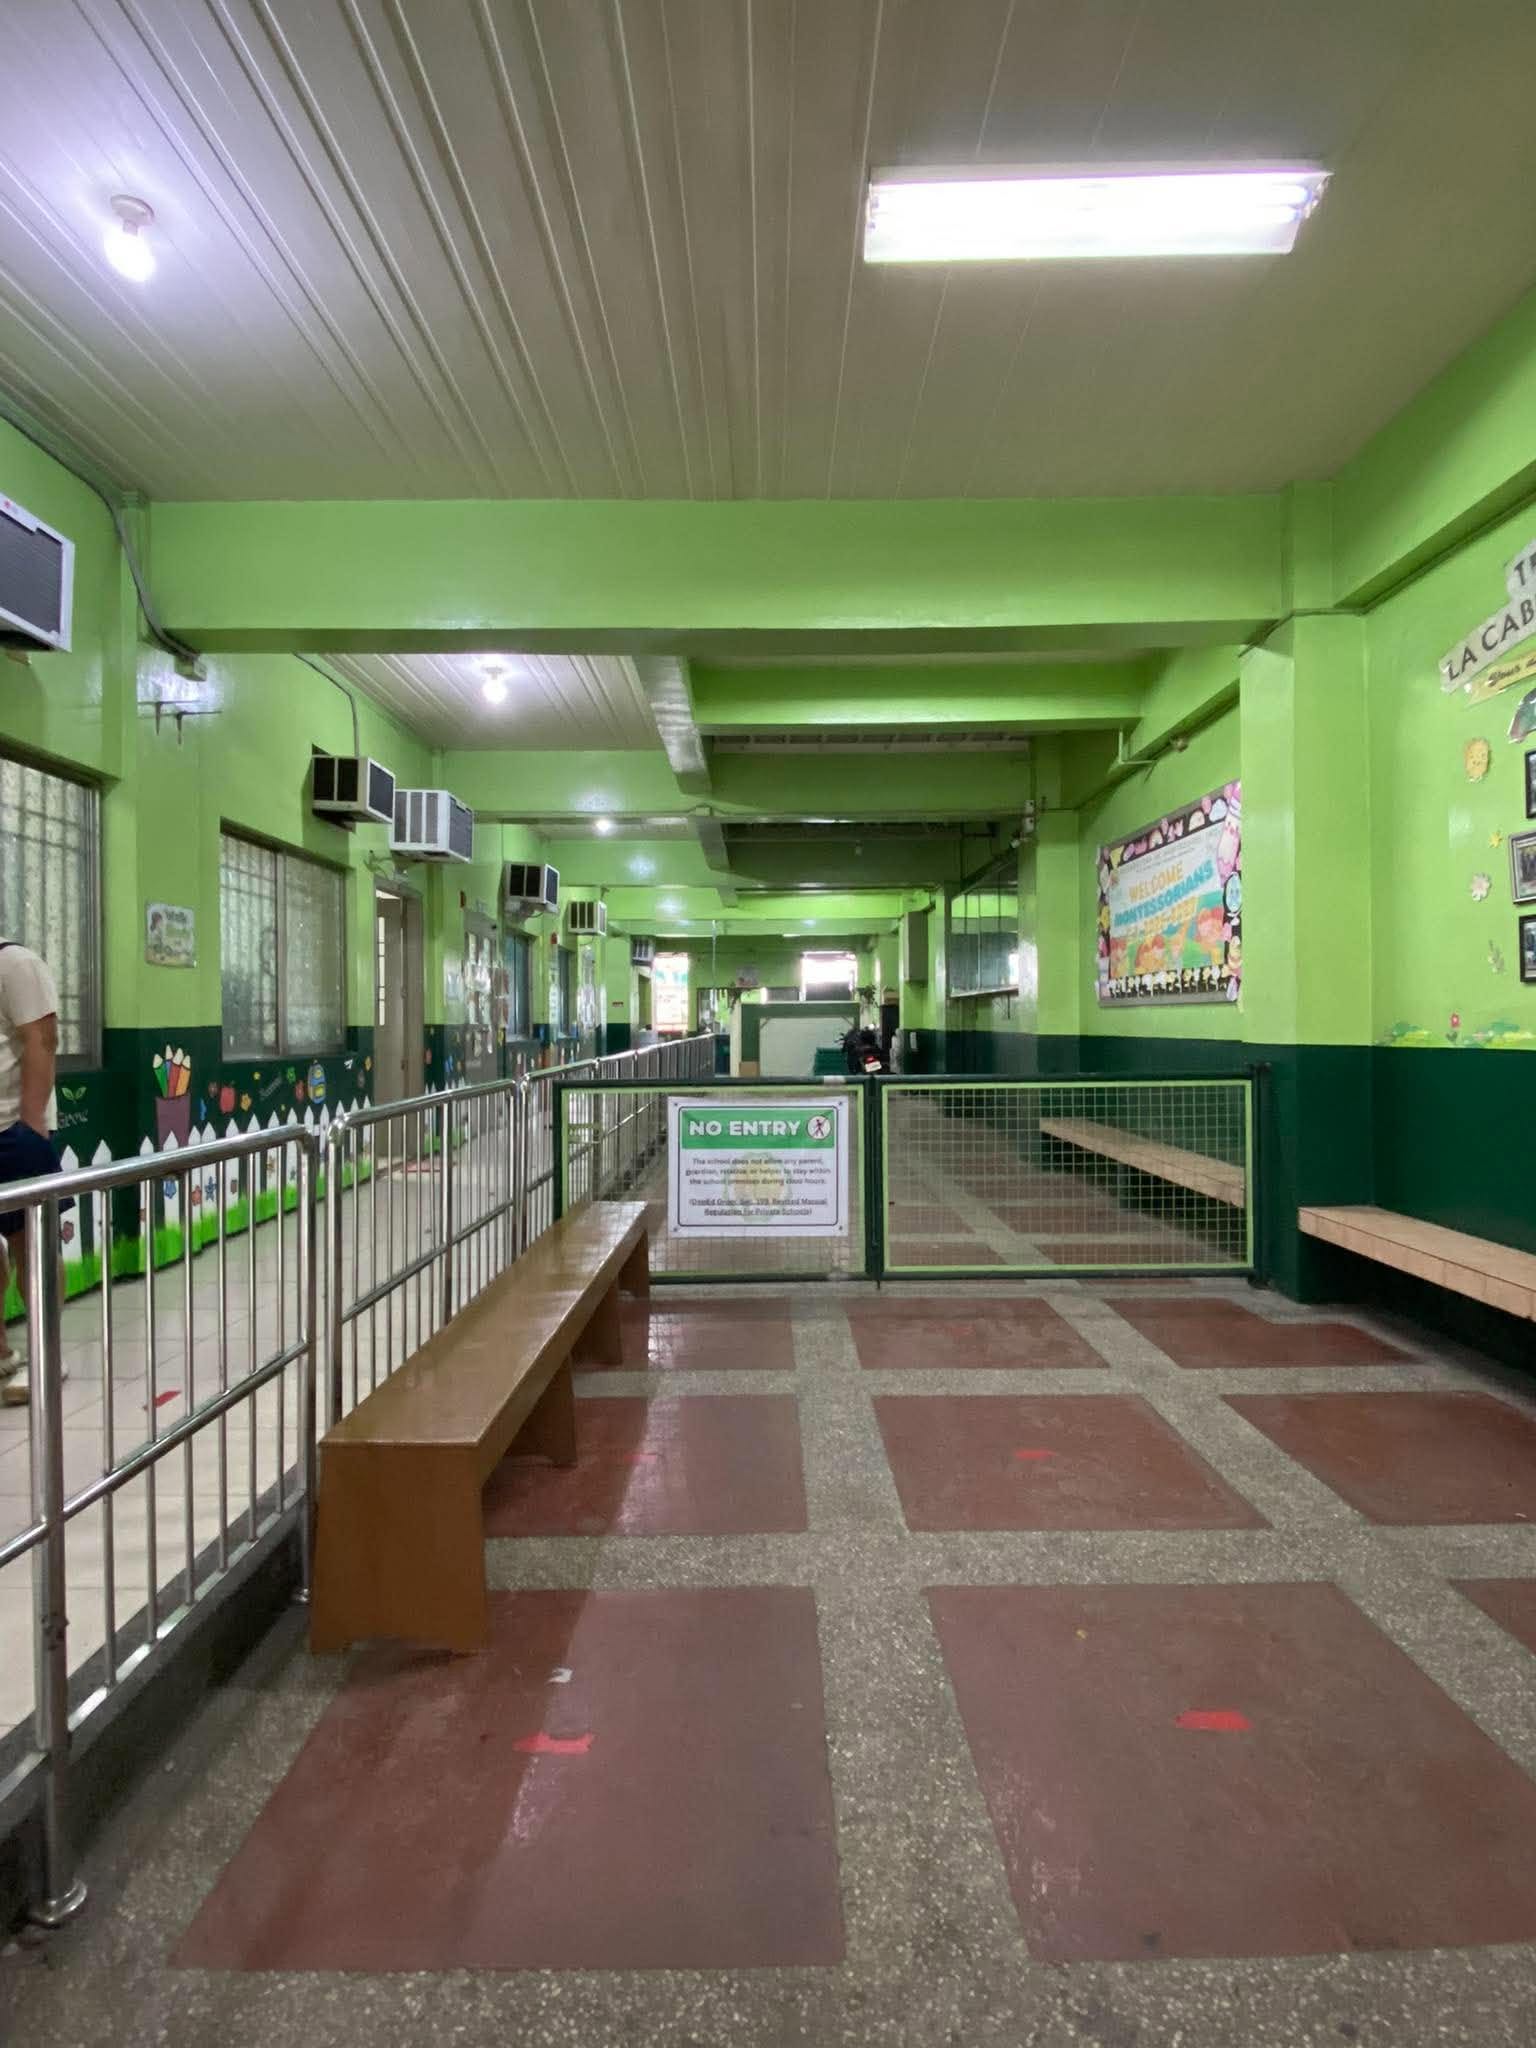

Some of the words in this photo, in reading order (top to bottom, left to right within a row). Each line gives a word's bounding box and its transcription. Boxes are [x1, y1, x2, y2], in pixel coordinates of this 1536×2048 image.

[1446, 646, 1478, 682] LA
[1481, 599, 1536, 652] CAB
[1129, 861, 1183, 902] WELCOME
[1114, 859, 1213, 928] MONTESSORIANS
[689, 1120, 722, 1136] NO
[729, 1120, 800, 1136] ENTRY
[784, 1158, 797, 1166] any
[759, 1168, 782, 1176] helper
[793, 1168, 807, 1176] stay
[761, 1178, 784, 1186] during
